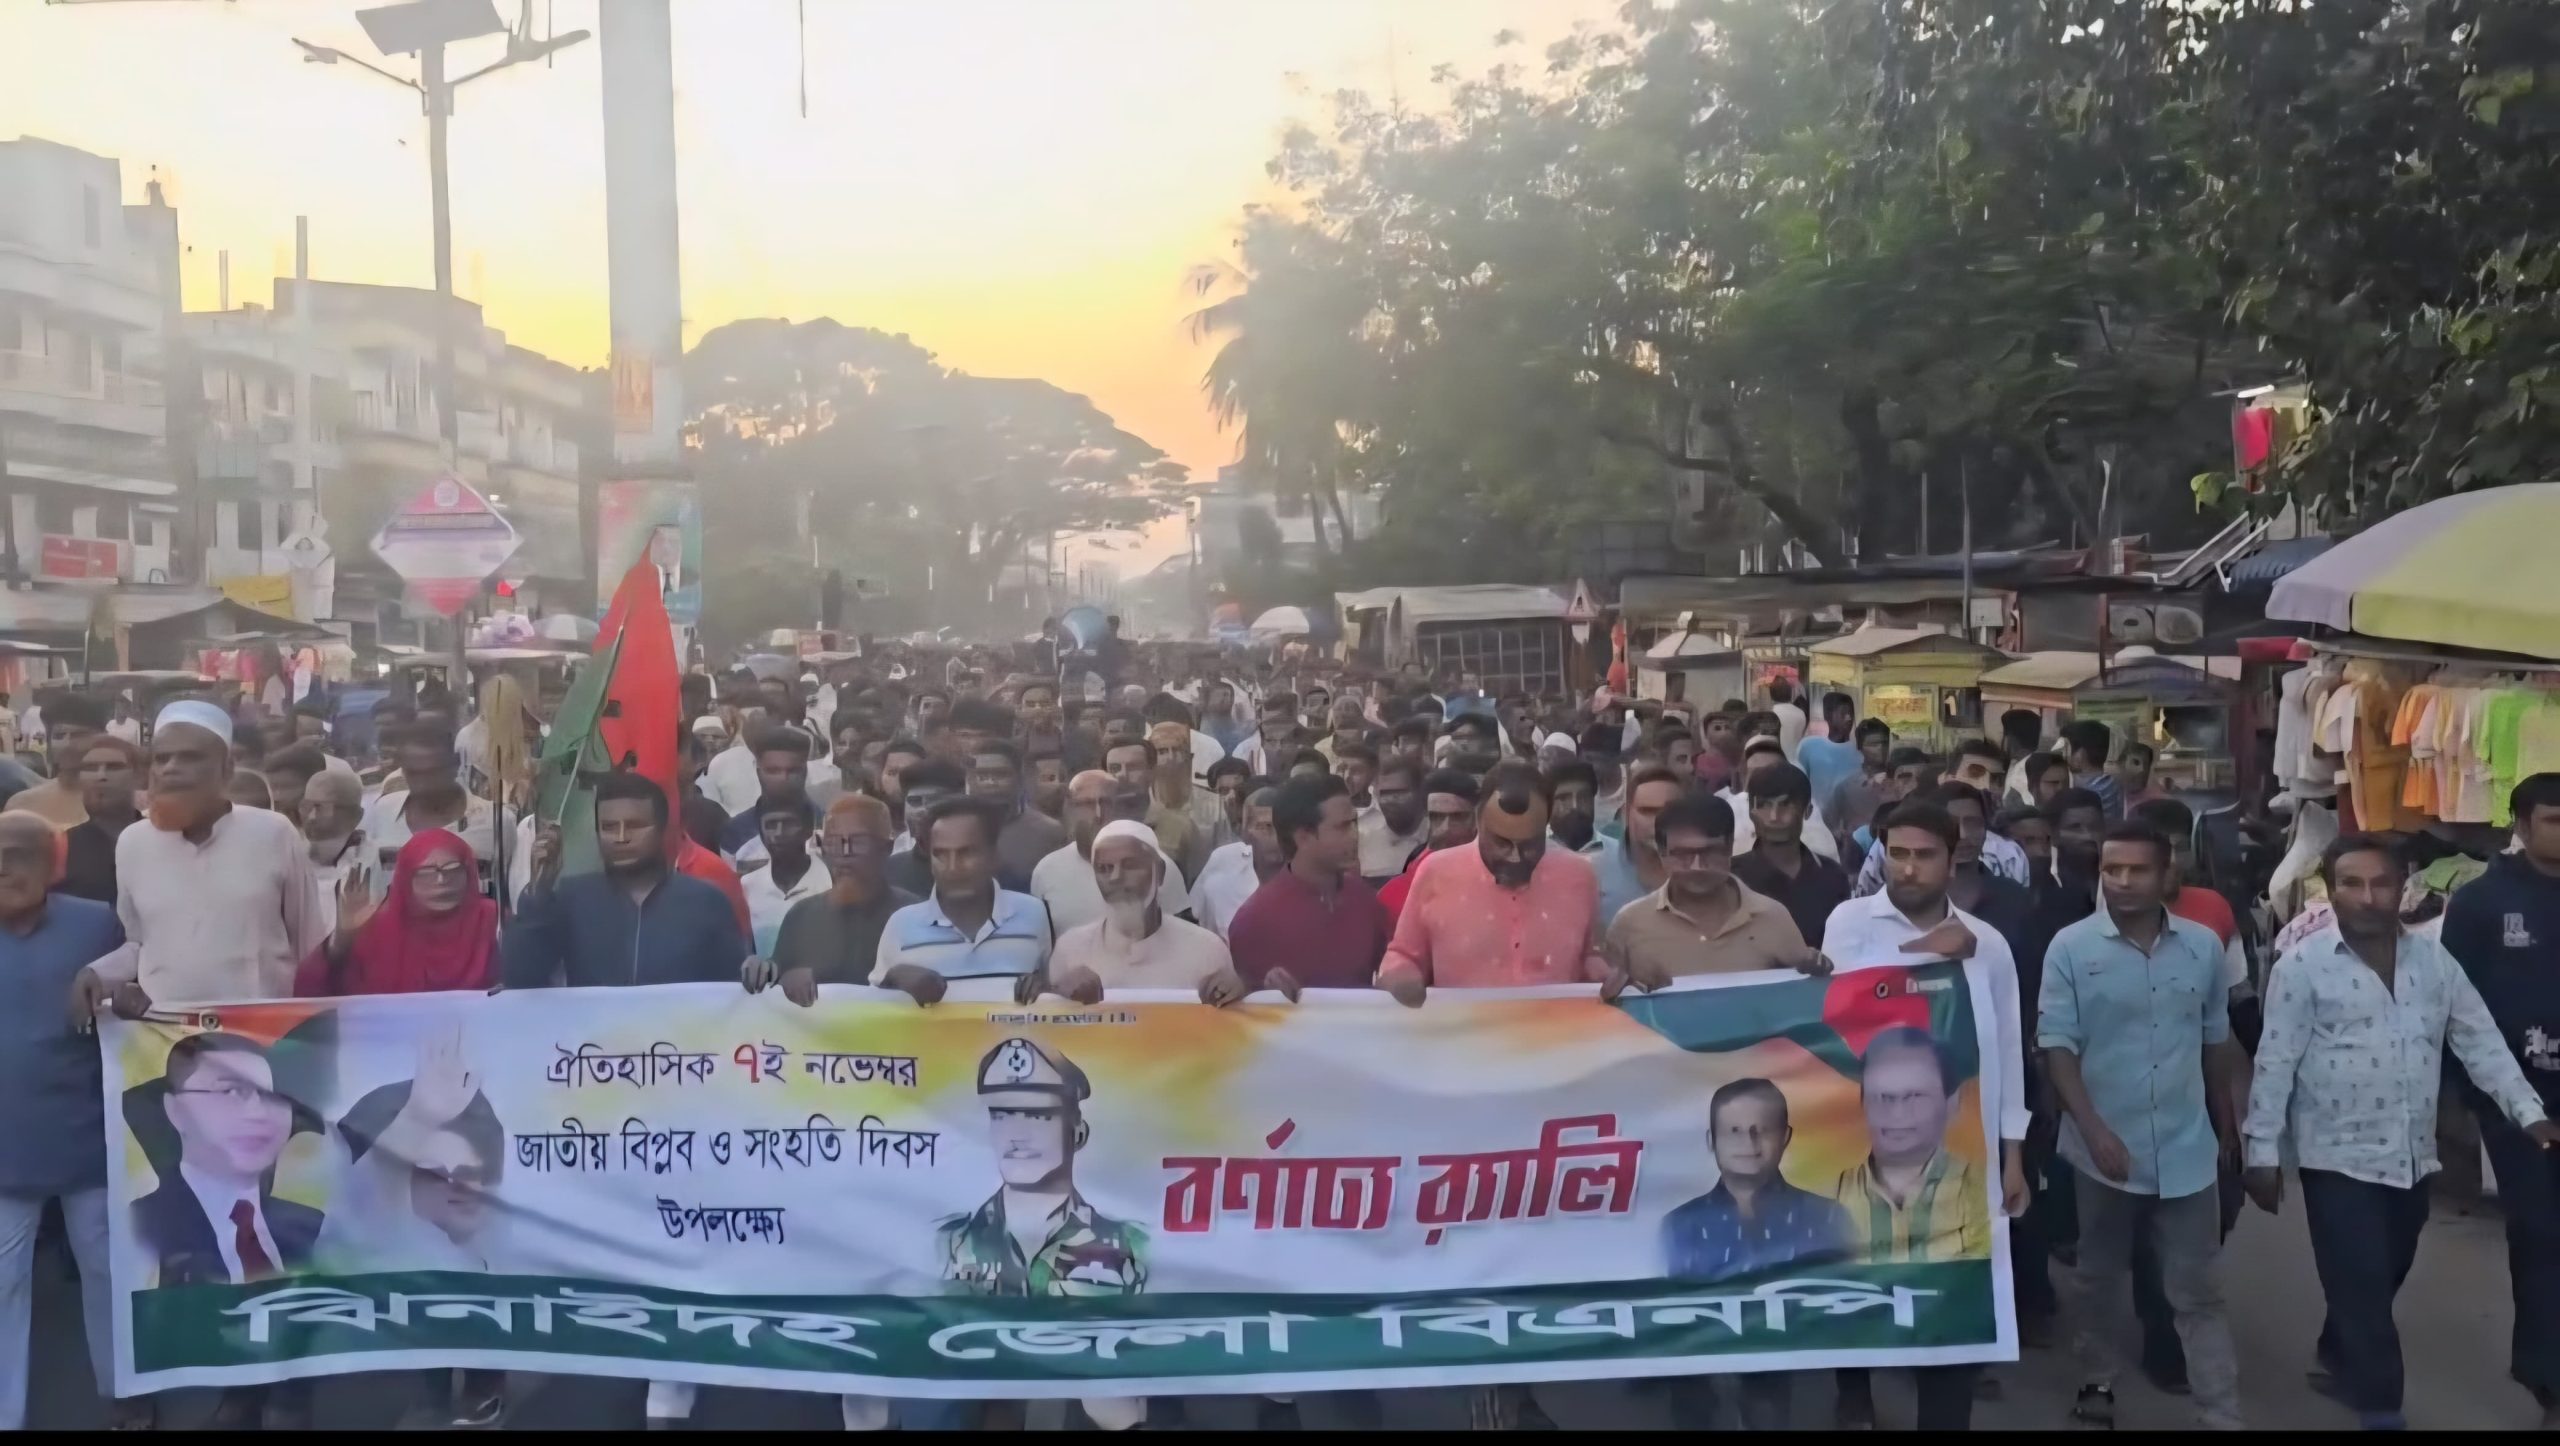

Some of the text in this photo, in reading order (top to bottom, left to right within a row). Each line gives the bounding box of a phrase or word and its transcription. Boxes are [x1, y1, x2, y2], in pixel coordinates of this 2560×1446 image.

[548, 1039, 918, 1088] ঐতিহাসিক ৭ই নভেম্বর
[515, 1113, 940, 1174] জাতীয় বিপ্লব ও সংহতি দিবস
[1162, 1117, 1401, 1232] বর্ণাঢ্য
[220, 1278, 1943, 1359] ঝিনাইদহ জেলা বিএনপি
